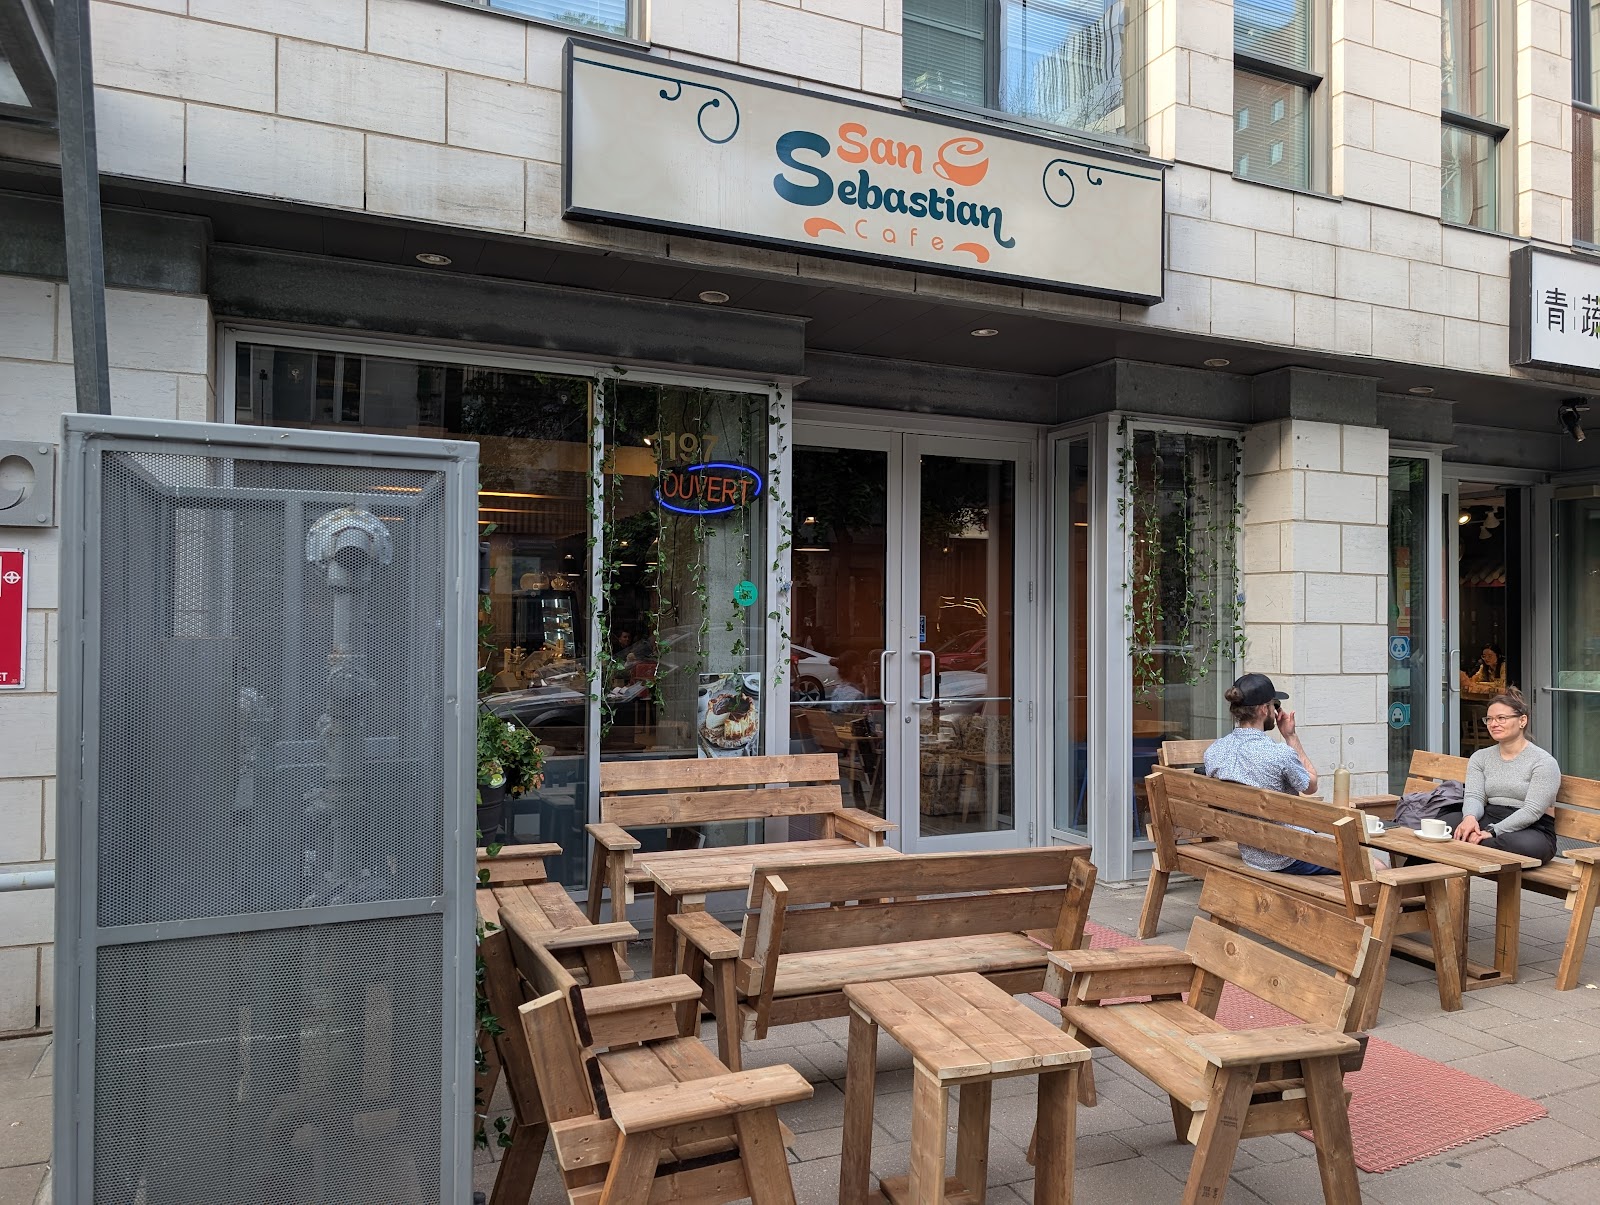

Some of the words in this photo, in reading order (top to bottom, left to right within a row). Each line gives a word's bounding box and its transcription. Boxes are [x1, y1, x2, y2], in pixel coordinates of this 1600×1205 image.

[835, 121, 923, 176] San
[773, 130, 1016, 249] Sebastian
[855, 218, 945, 251] Cafe
[663, 472, 753, 506] OUVERT
